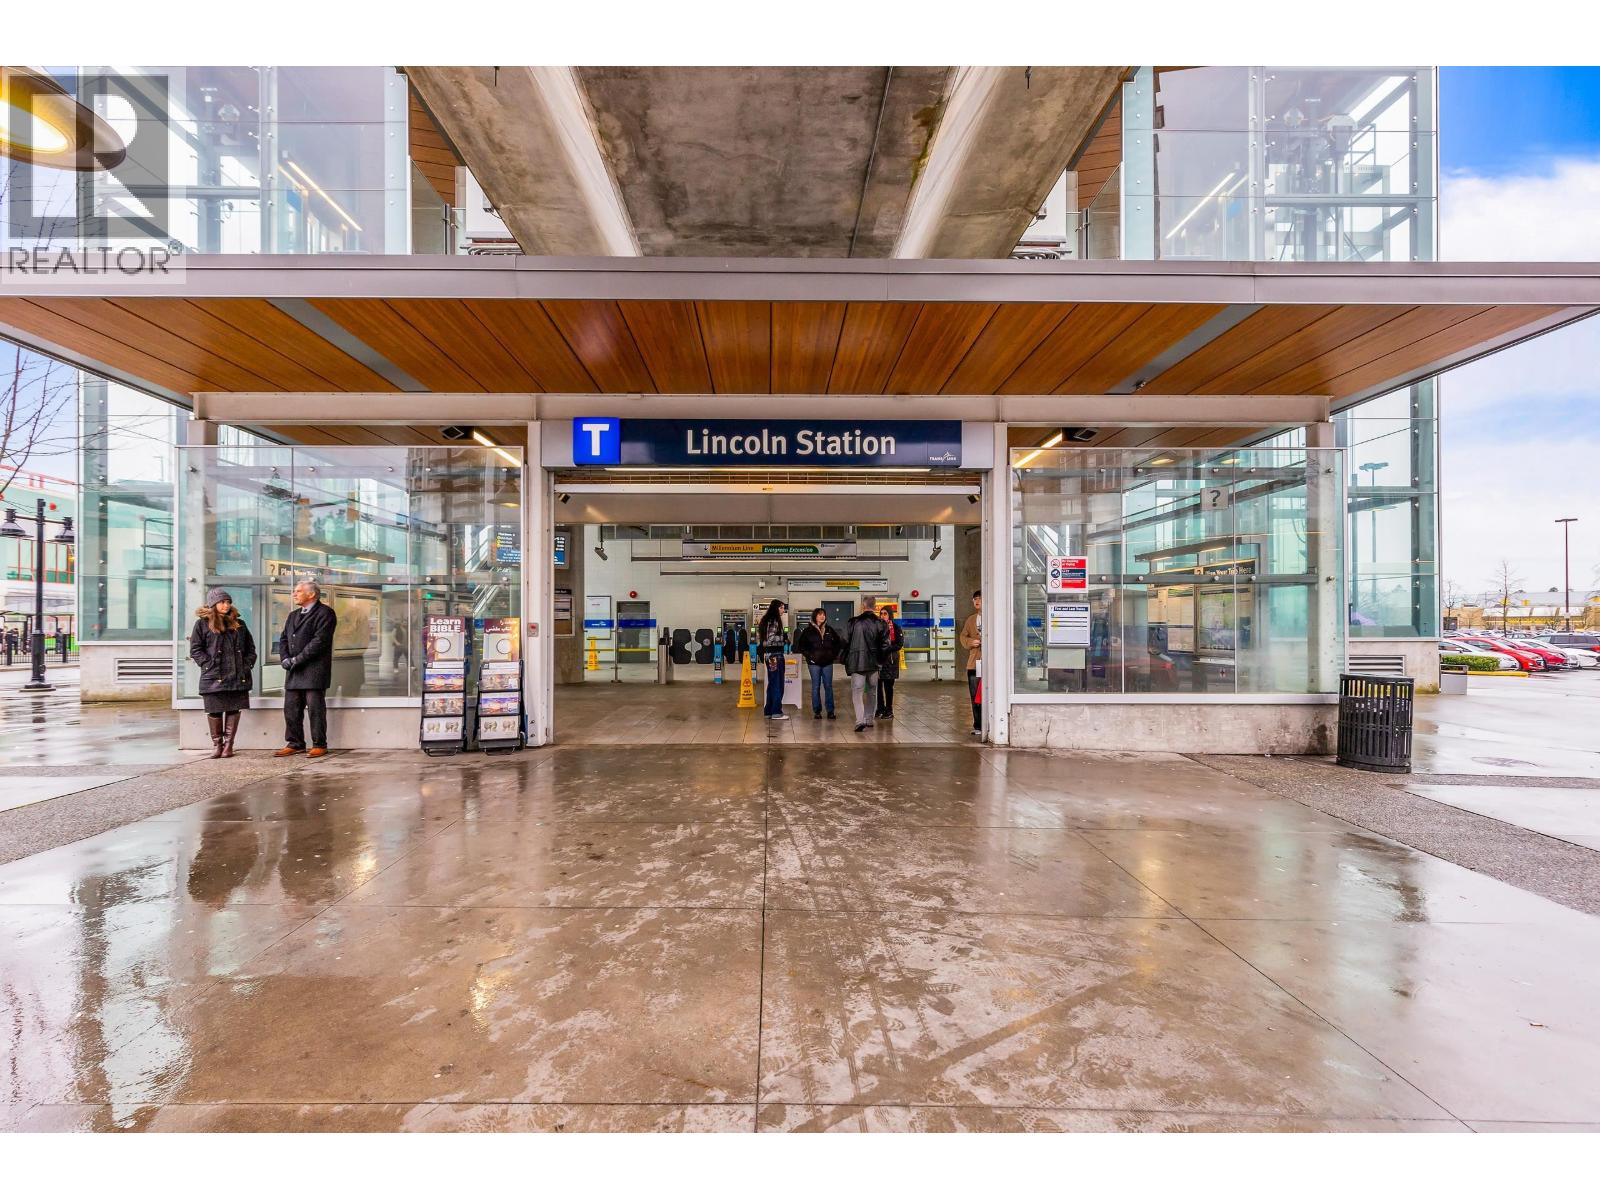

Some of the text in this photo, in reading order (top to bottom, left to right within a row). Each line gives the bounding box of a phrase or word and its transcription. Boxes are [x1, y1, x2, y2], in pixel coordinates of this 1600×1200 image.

[582, 423, 610, 456] T
[687, 429, 896, 455] Lincoln Station
[430, 617, 462, 625] Learn
[430, 625, 461, 633] BIBLE
